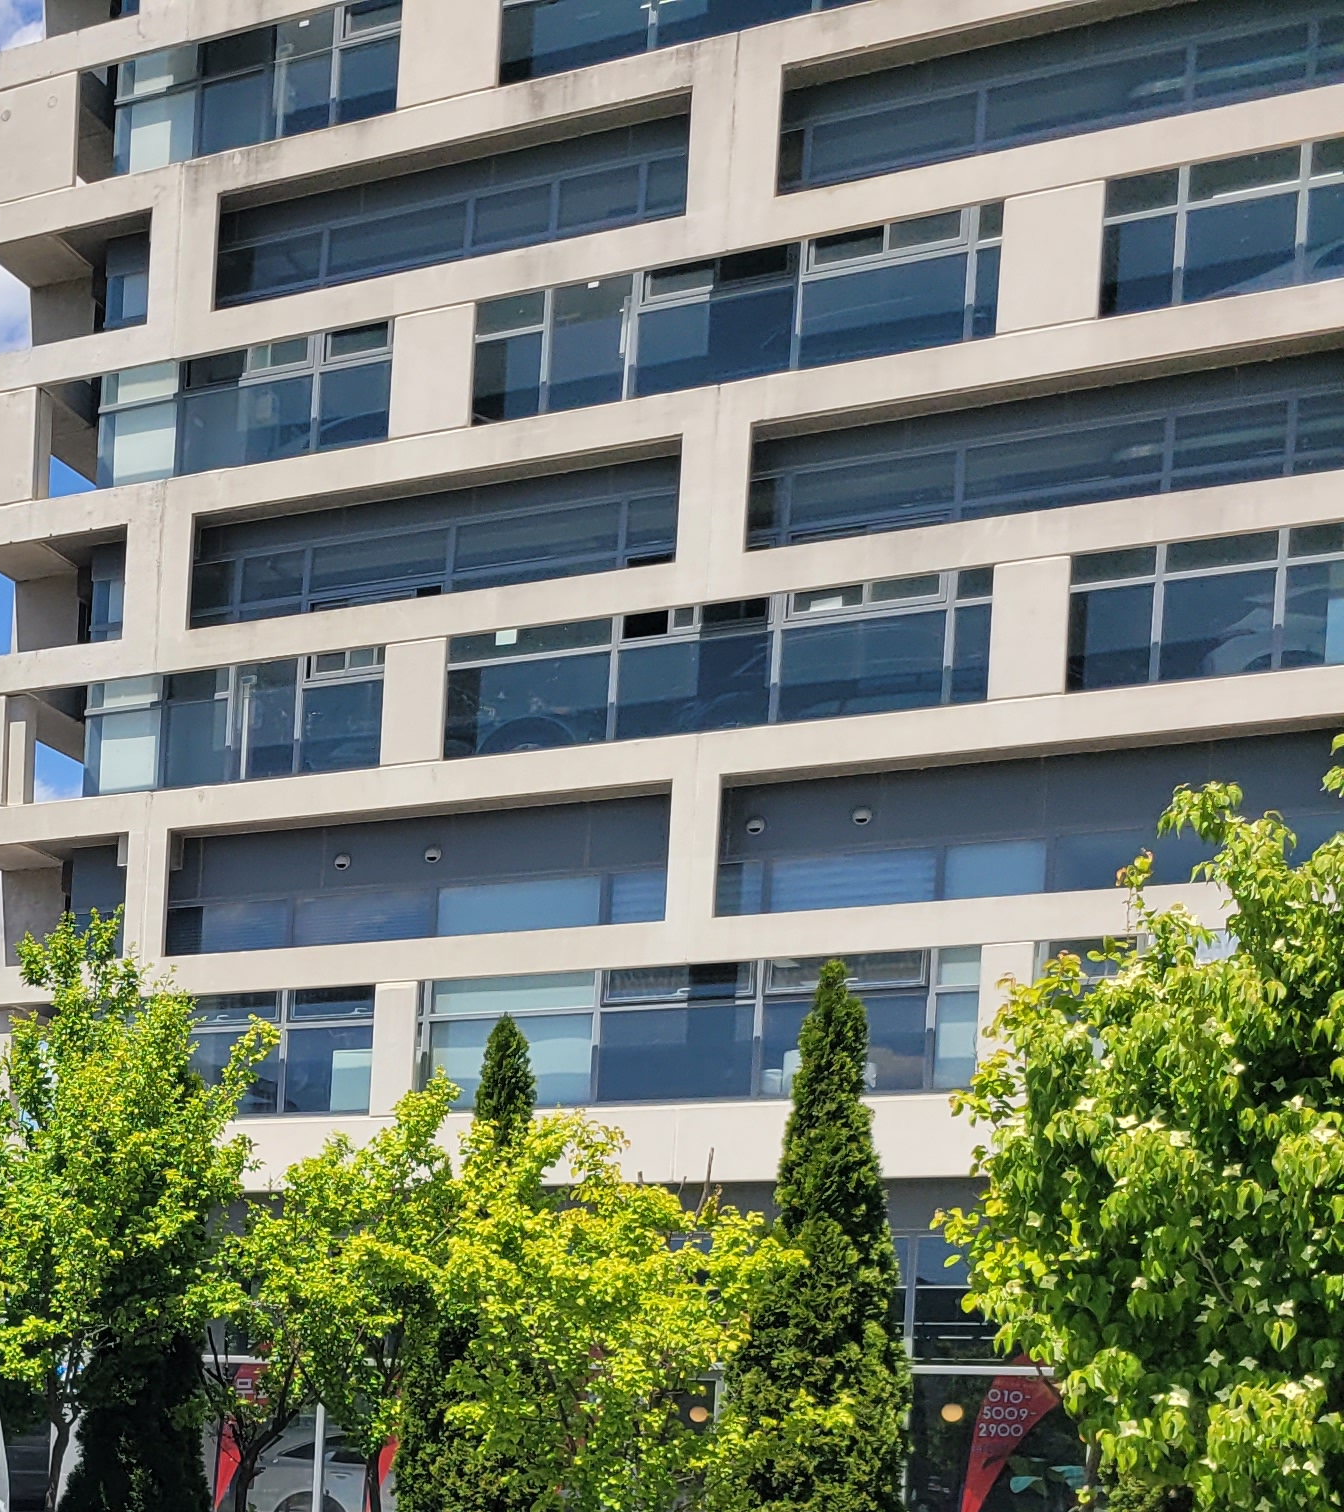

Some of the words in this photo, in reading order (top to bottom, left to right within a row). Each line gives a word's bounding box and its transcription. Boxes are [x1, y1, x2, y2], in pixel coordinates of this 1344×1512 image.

[987, 1388, 1032, 1404] 010-
[982, 1405, 1038, 1421] 5009-
[978, 1422, 1024, 1438] 2900
